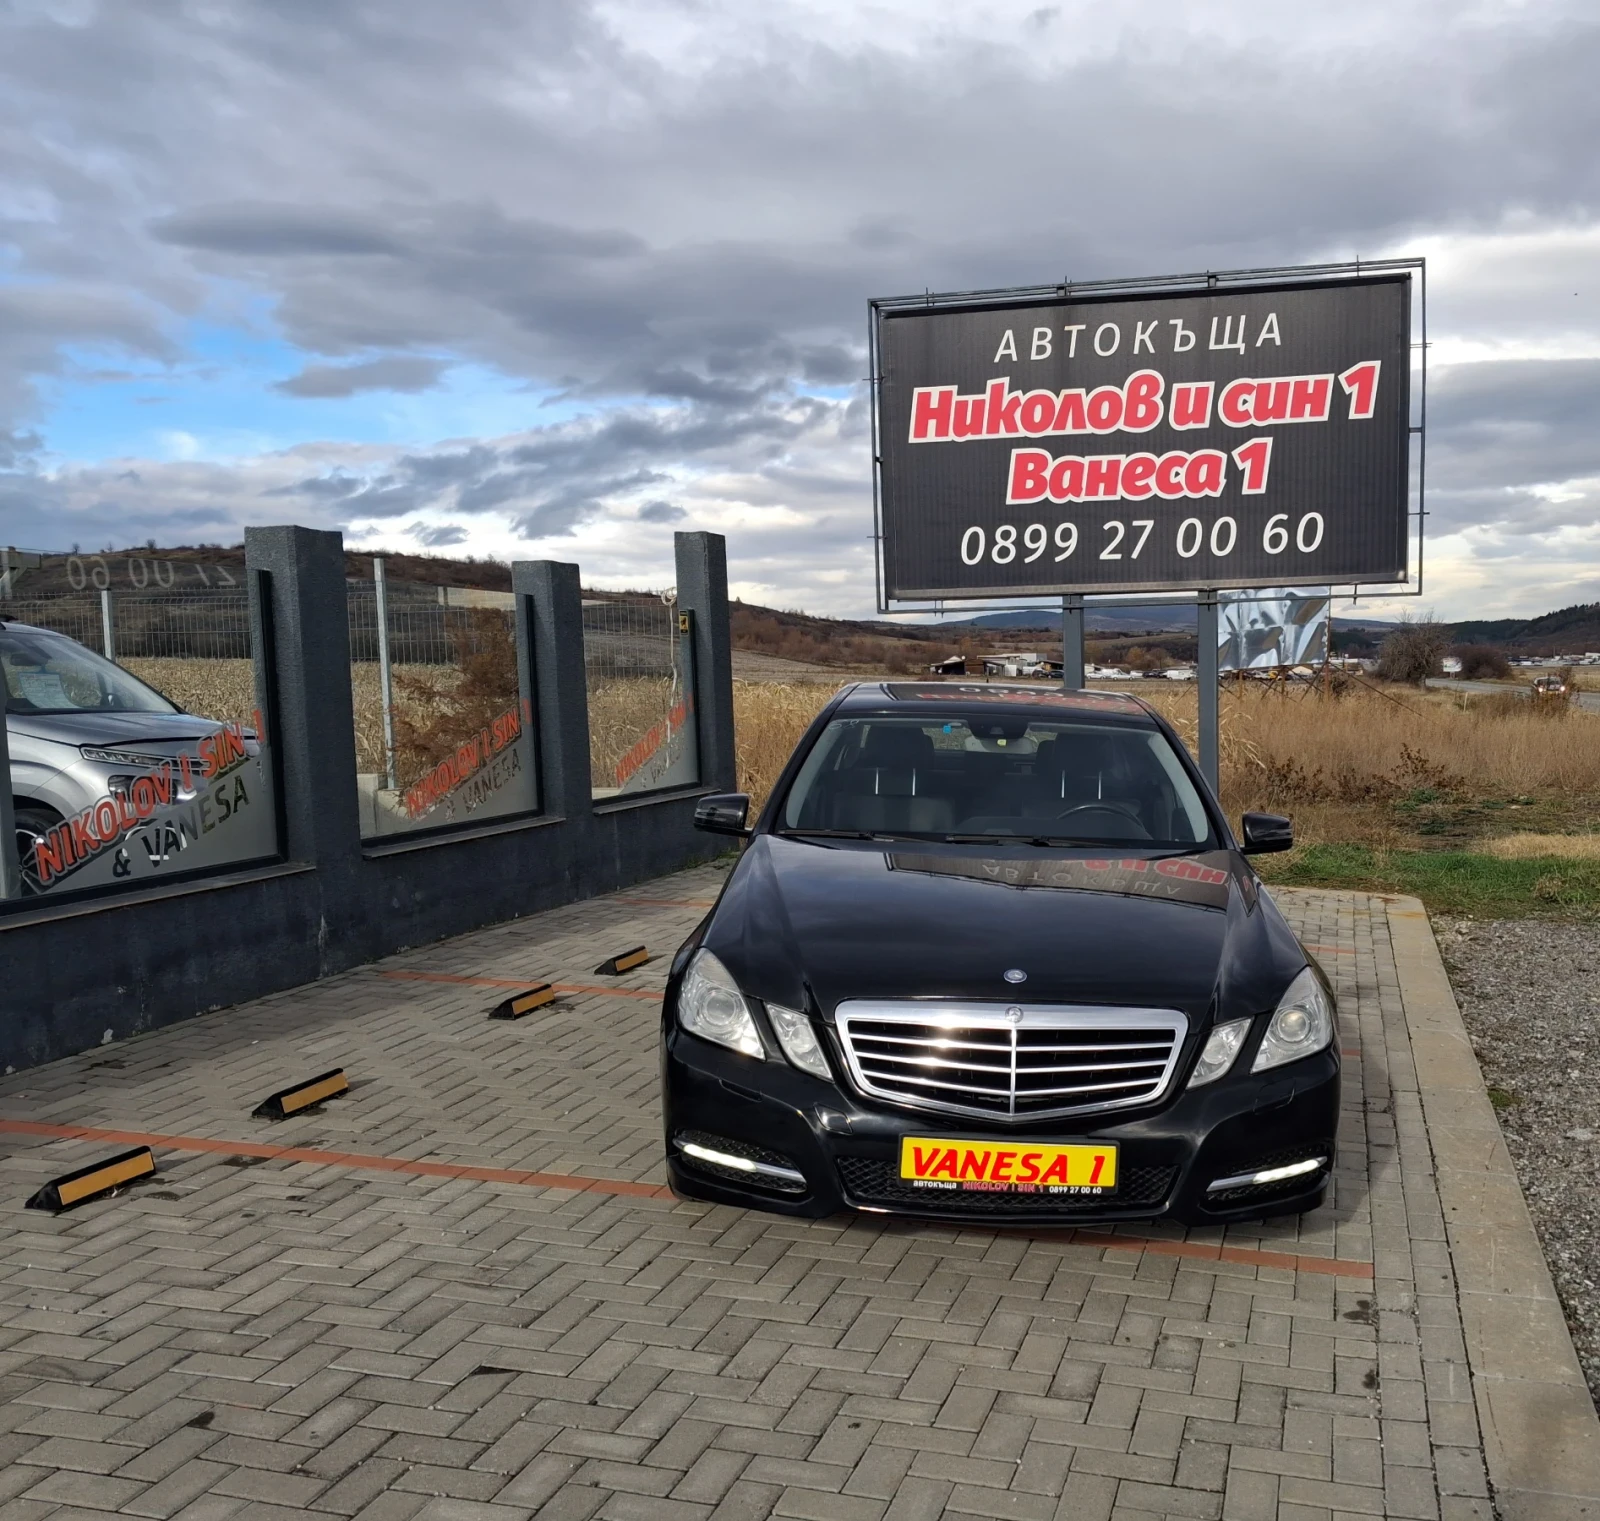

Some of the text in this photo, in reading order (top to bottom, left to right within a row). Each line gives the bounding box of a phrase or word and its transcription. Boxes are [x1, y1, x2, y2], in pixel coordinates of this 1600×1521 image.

[994, 312, 1282, 363] АВТОКЪЩА
[908, 360, 1381, 443] Николов и син 1
[1006, 437, 1273, 505] Ванеса 1
[960, 512, 1325, 566] 0899 27 00 60
[405, 735, 480, 818] NIKOLOV
[492, 705, 520, 752] SIN
[35, 761, 172, 885] NIKOLOV
[197, 721, 245, 779] SIN
[112, 848, 131, 877] &
[141, 775, 250, 867] VANESA
[912, 1147, 1105, 1184] VANESA 1
[913, 1180, 957, 1190] автокъща
[962, 1181, 1009, 1192] NIKOLOV
[1069, 1186, 1079, 1194] 27
